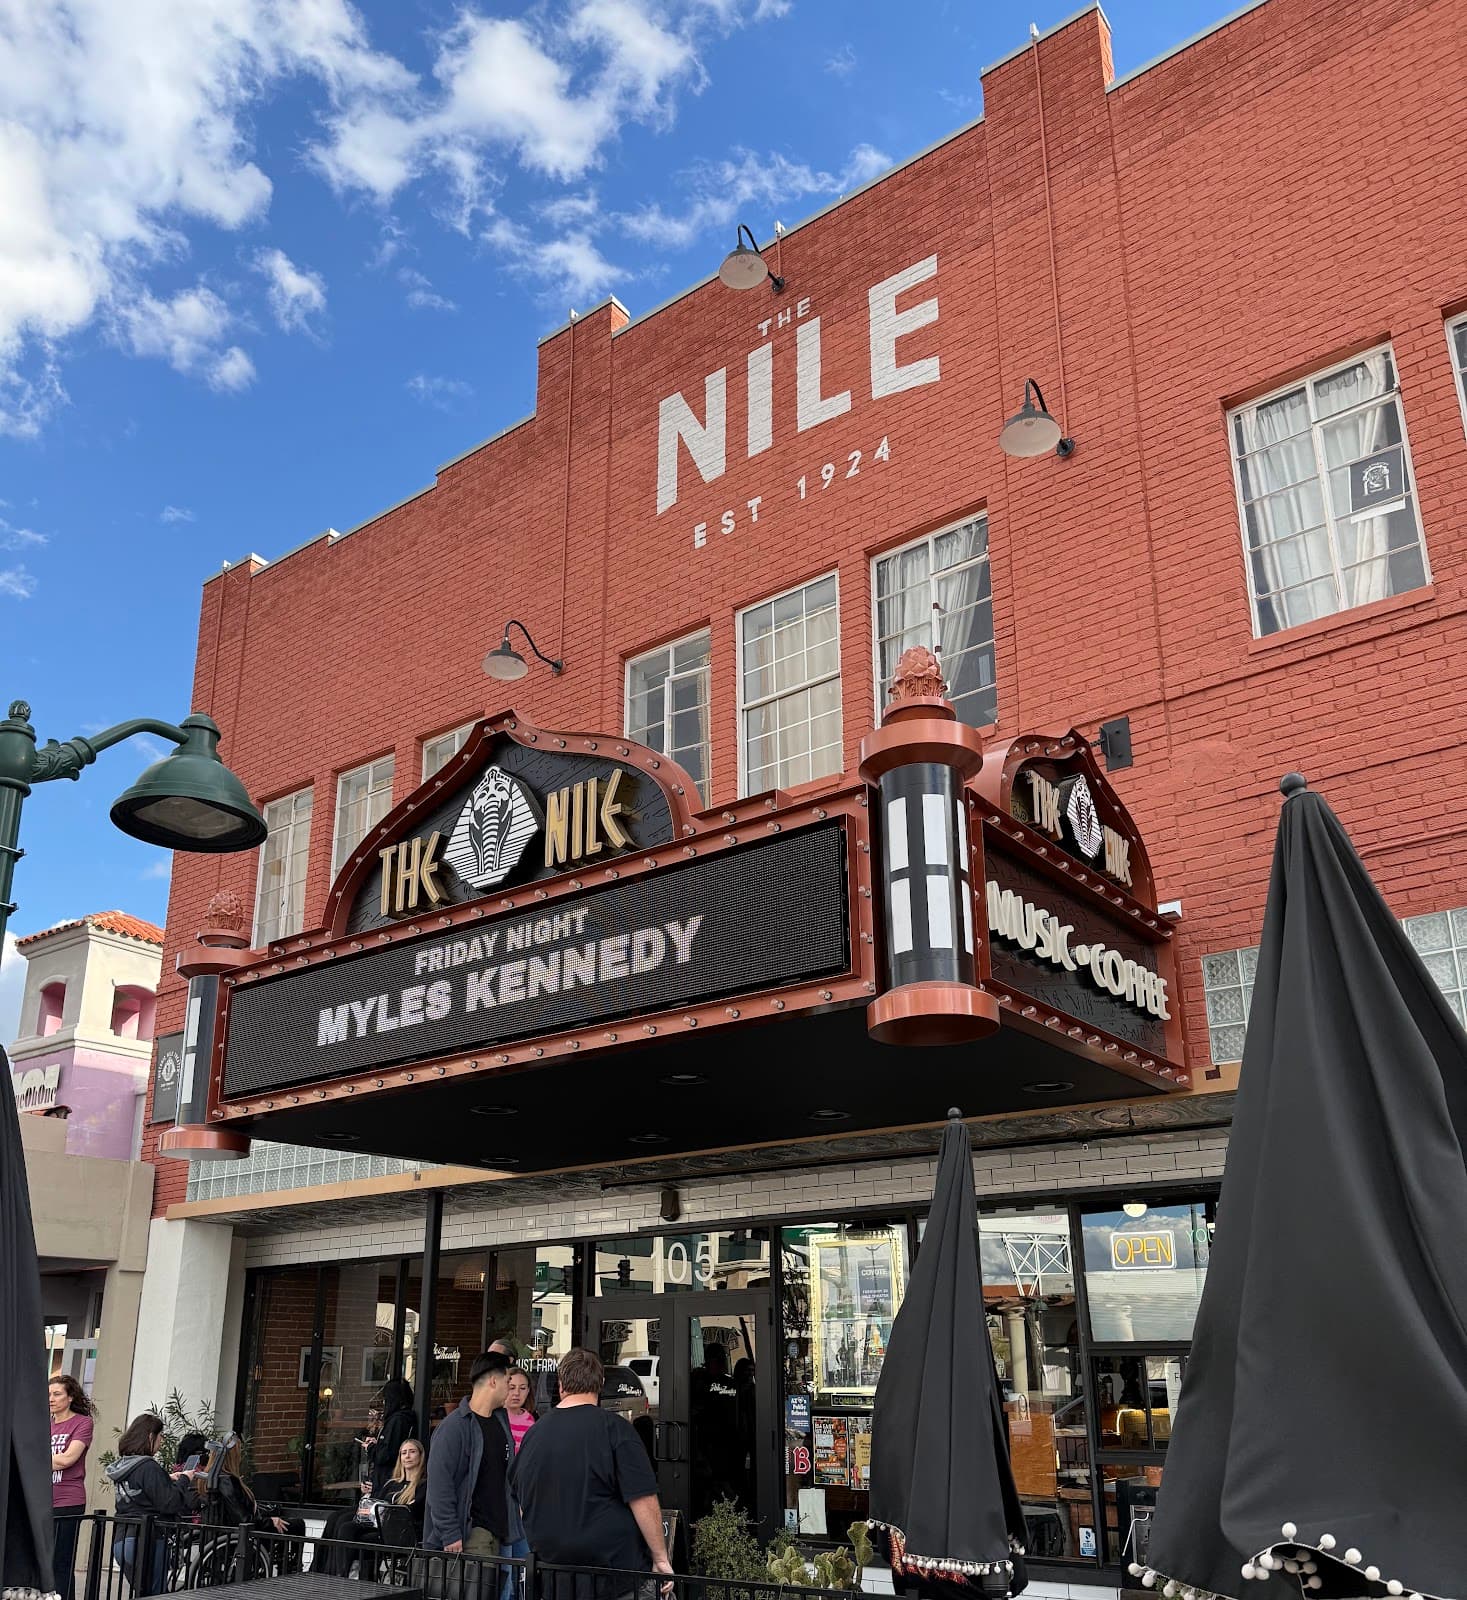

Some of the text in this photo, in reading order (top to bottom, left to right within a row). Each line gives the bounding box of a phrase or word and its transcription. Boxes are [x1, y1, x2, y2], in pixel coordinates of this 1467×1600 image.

[758, 296, 811, 337] THE
[656, 252, 941, 516] NILE
[694, 435, 891, 549] EST 1924
[379, 768, 626, 916] THE NILE
[414, 907, 590, 976] FRIDAY NIGHT
[986, 880, 1078, 972] MUSIC
[316, 914, 703, 1047] MYLES KENNEDY
[650, 1240, 715, 1284] 105
[1114, 1235, 1172, 1264] OPEN
[793, 1446, 811, 1475] B
